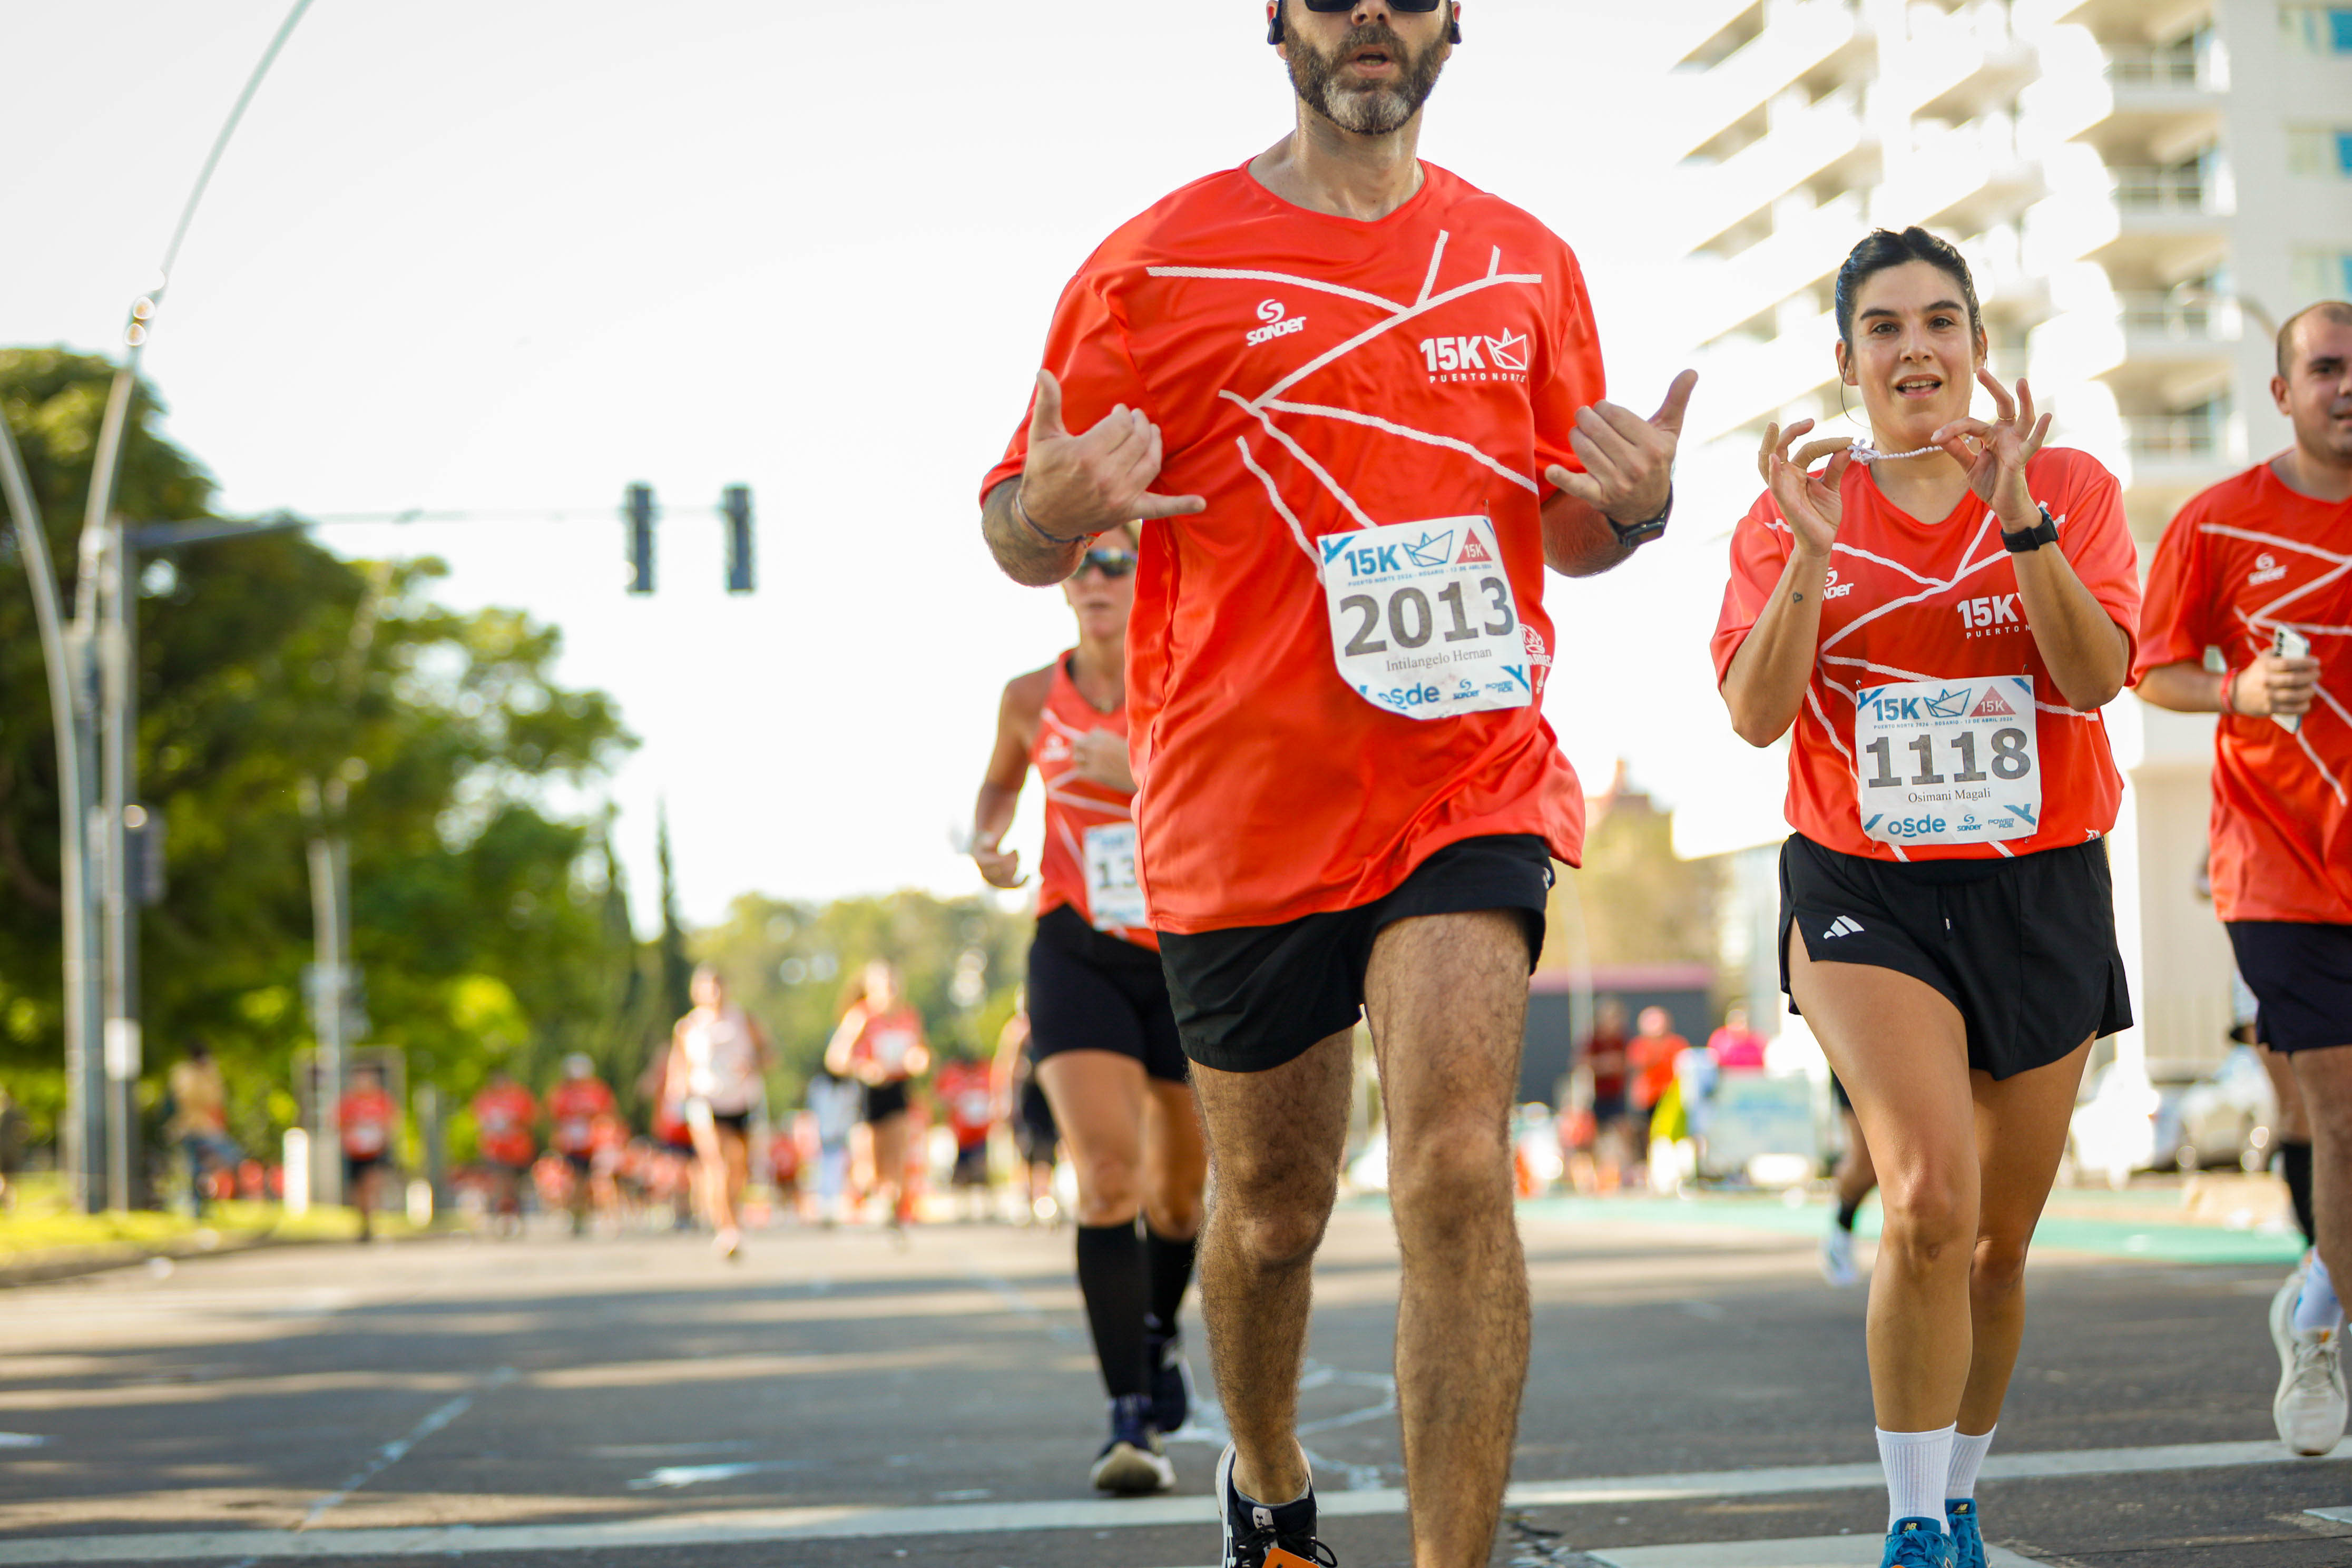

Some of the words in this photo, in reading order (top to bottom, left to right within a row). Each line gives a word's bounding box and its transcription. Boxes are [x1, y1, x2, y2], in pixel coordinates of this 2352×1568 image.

[1420, 335, 1486, 372] 15K
[1429, 372, 1486, 384] PUERTO
[1492, 372, 1526, 383] NORTE
[1345, 544, 1402, 577] 15K
[1464, 543, 1484, 558] 15K
[1339, 576, 1515, 657] 2013
[1957, 593, 2019, 629] 15K
[1966, 625, 2020, 640] PUERTO
[1386, 654, 1451, 672] Intilangelo
[1453, 649, 1493, 662] Hernan
[1873, 697, 1920, 722] 15K
[1980, 700, 2005, 713] 15K
[1866, 727, 2031, 788] 1118
[1908, 790, 1952, 803] Osimani
[1955, 787, 1991, 800] Magali
[1888, 814, 1947, 837] osde
